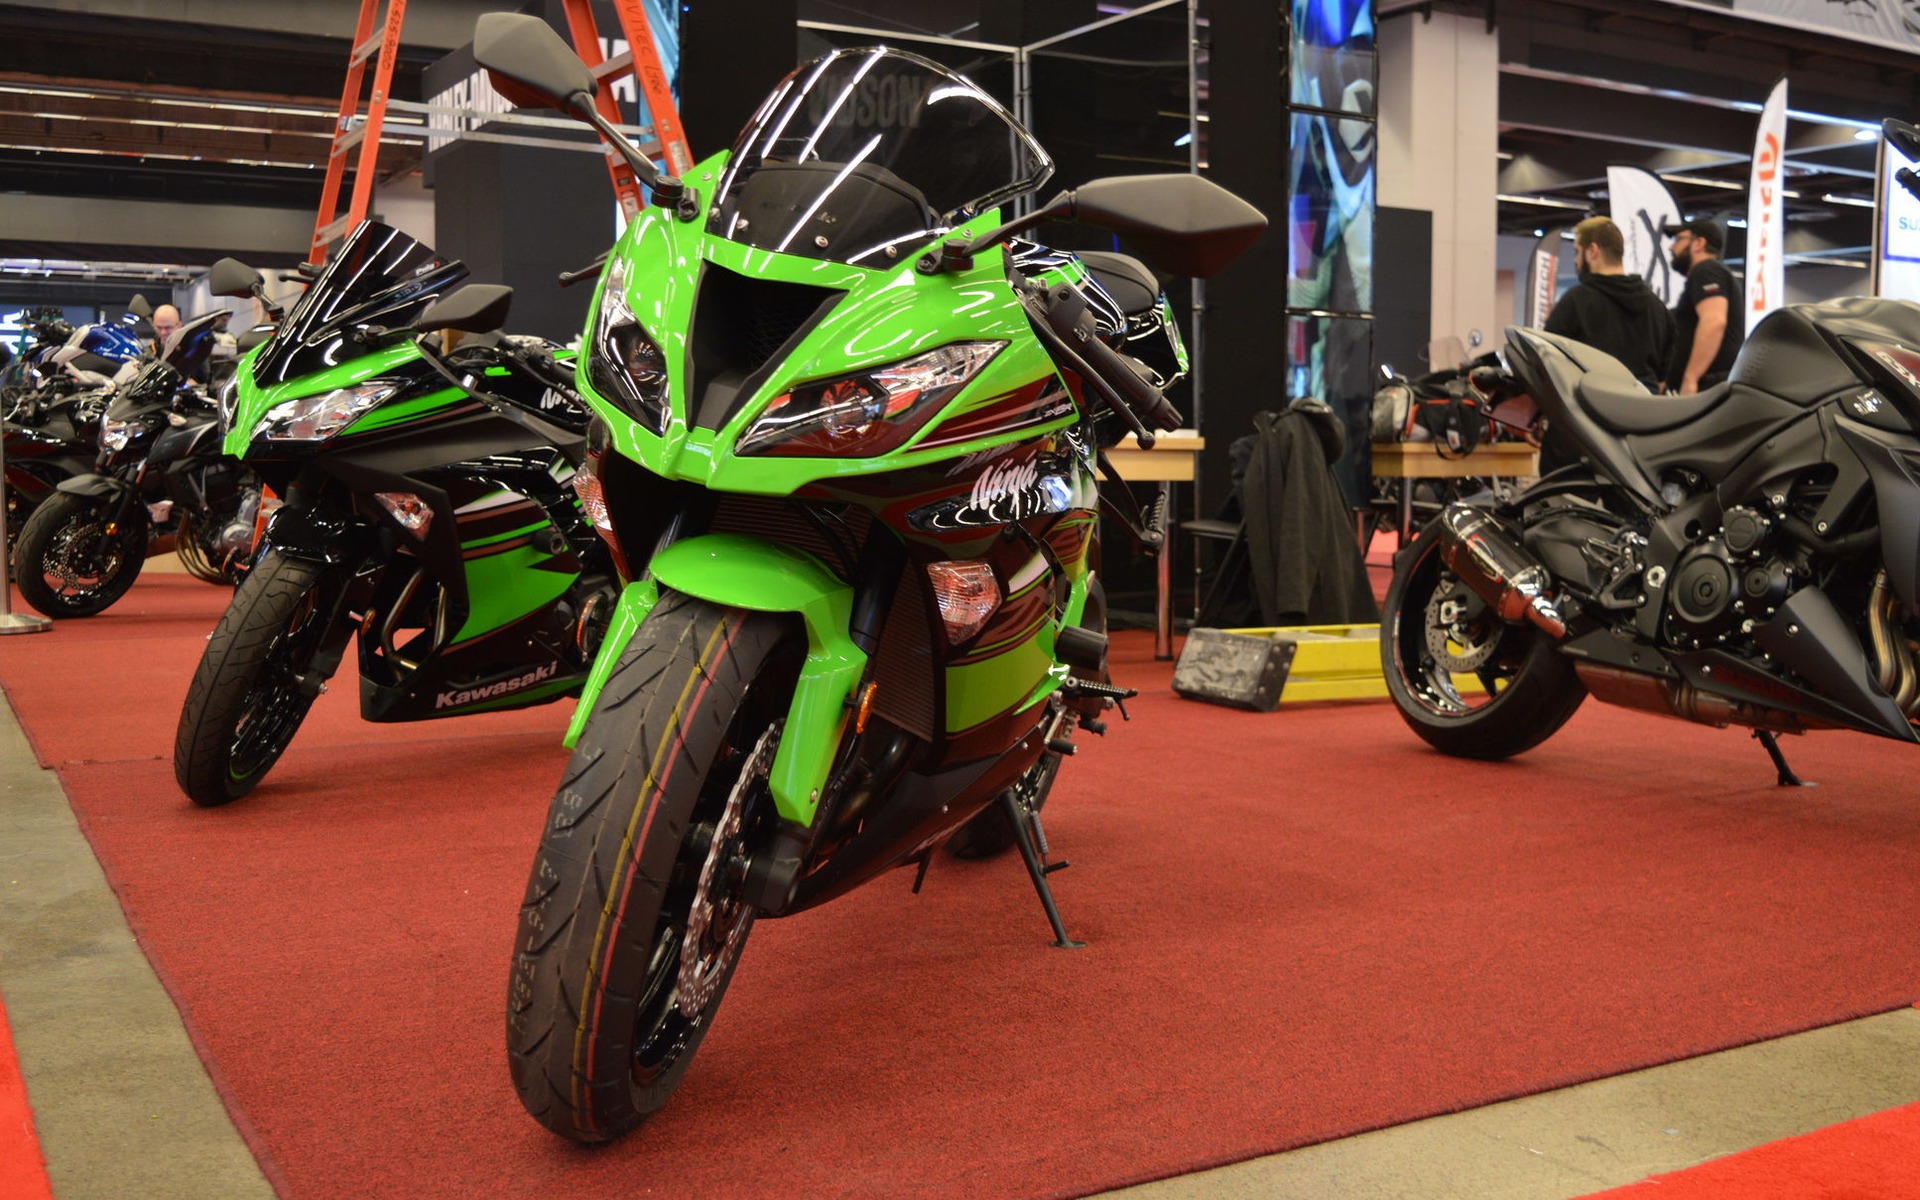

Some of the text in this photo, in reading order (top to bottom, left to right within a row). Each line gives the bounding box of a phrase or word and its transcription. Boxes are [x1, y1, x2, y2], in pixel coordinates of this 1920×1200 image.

[1898, 216, 1920, 231] SU
[969, 450, 1038, 514] Ninja
[435, 660, 558, 709] Kawasaki
